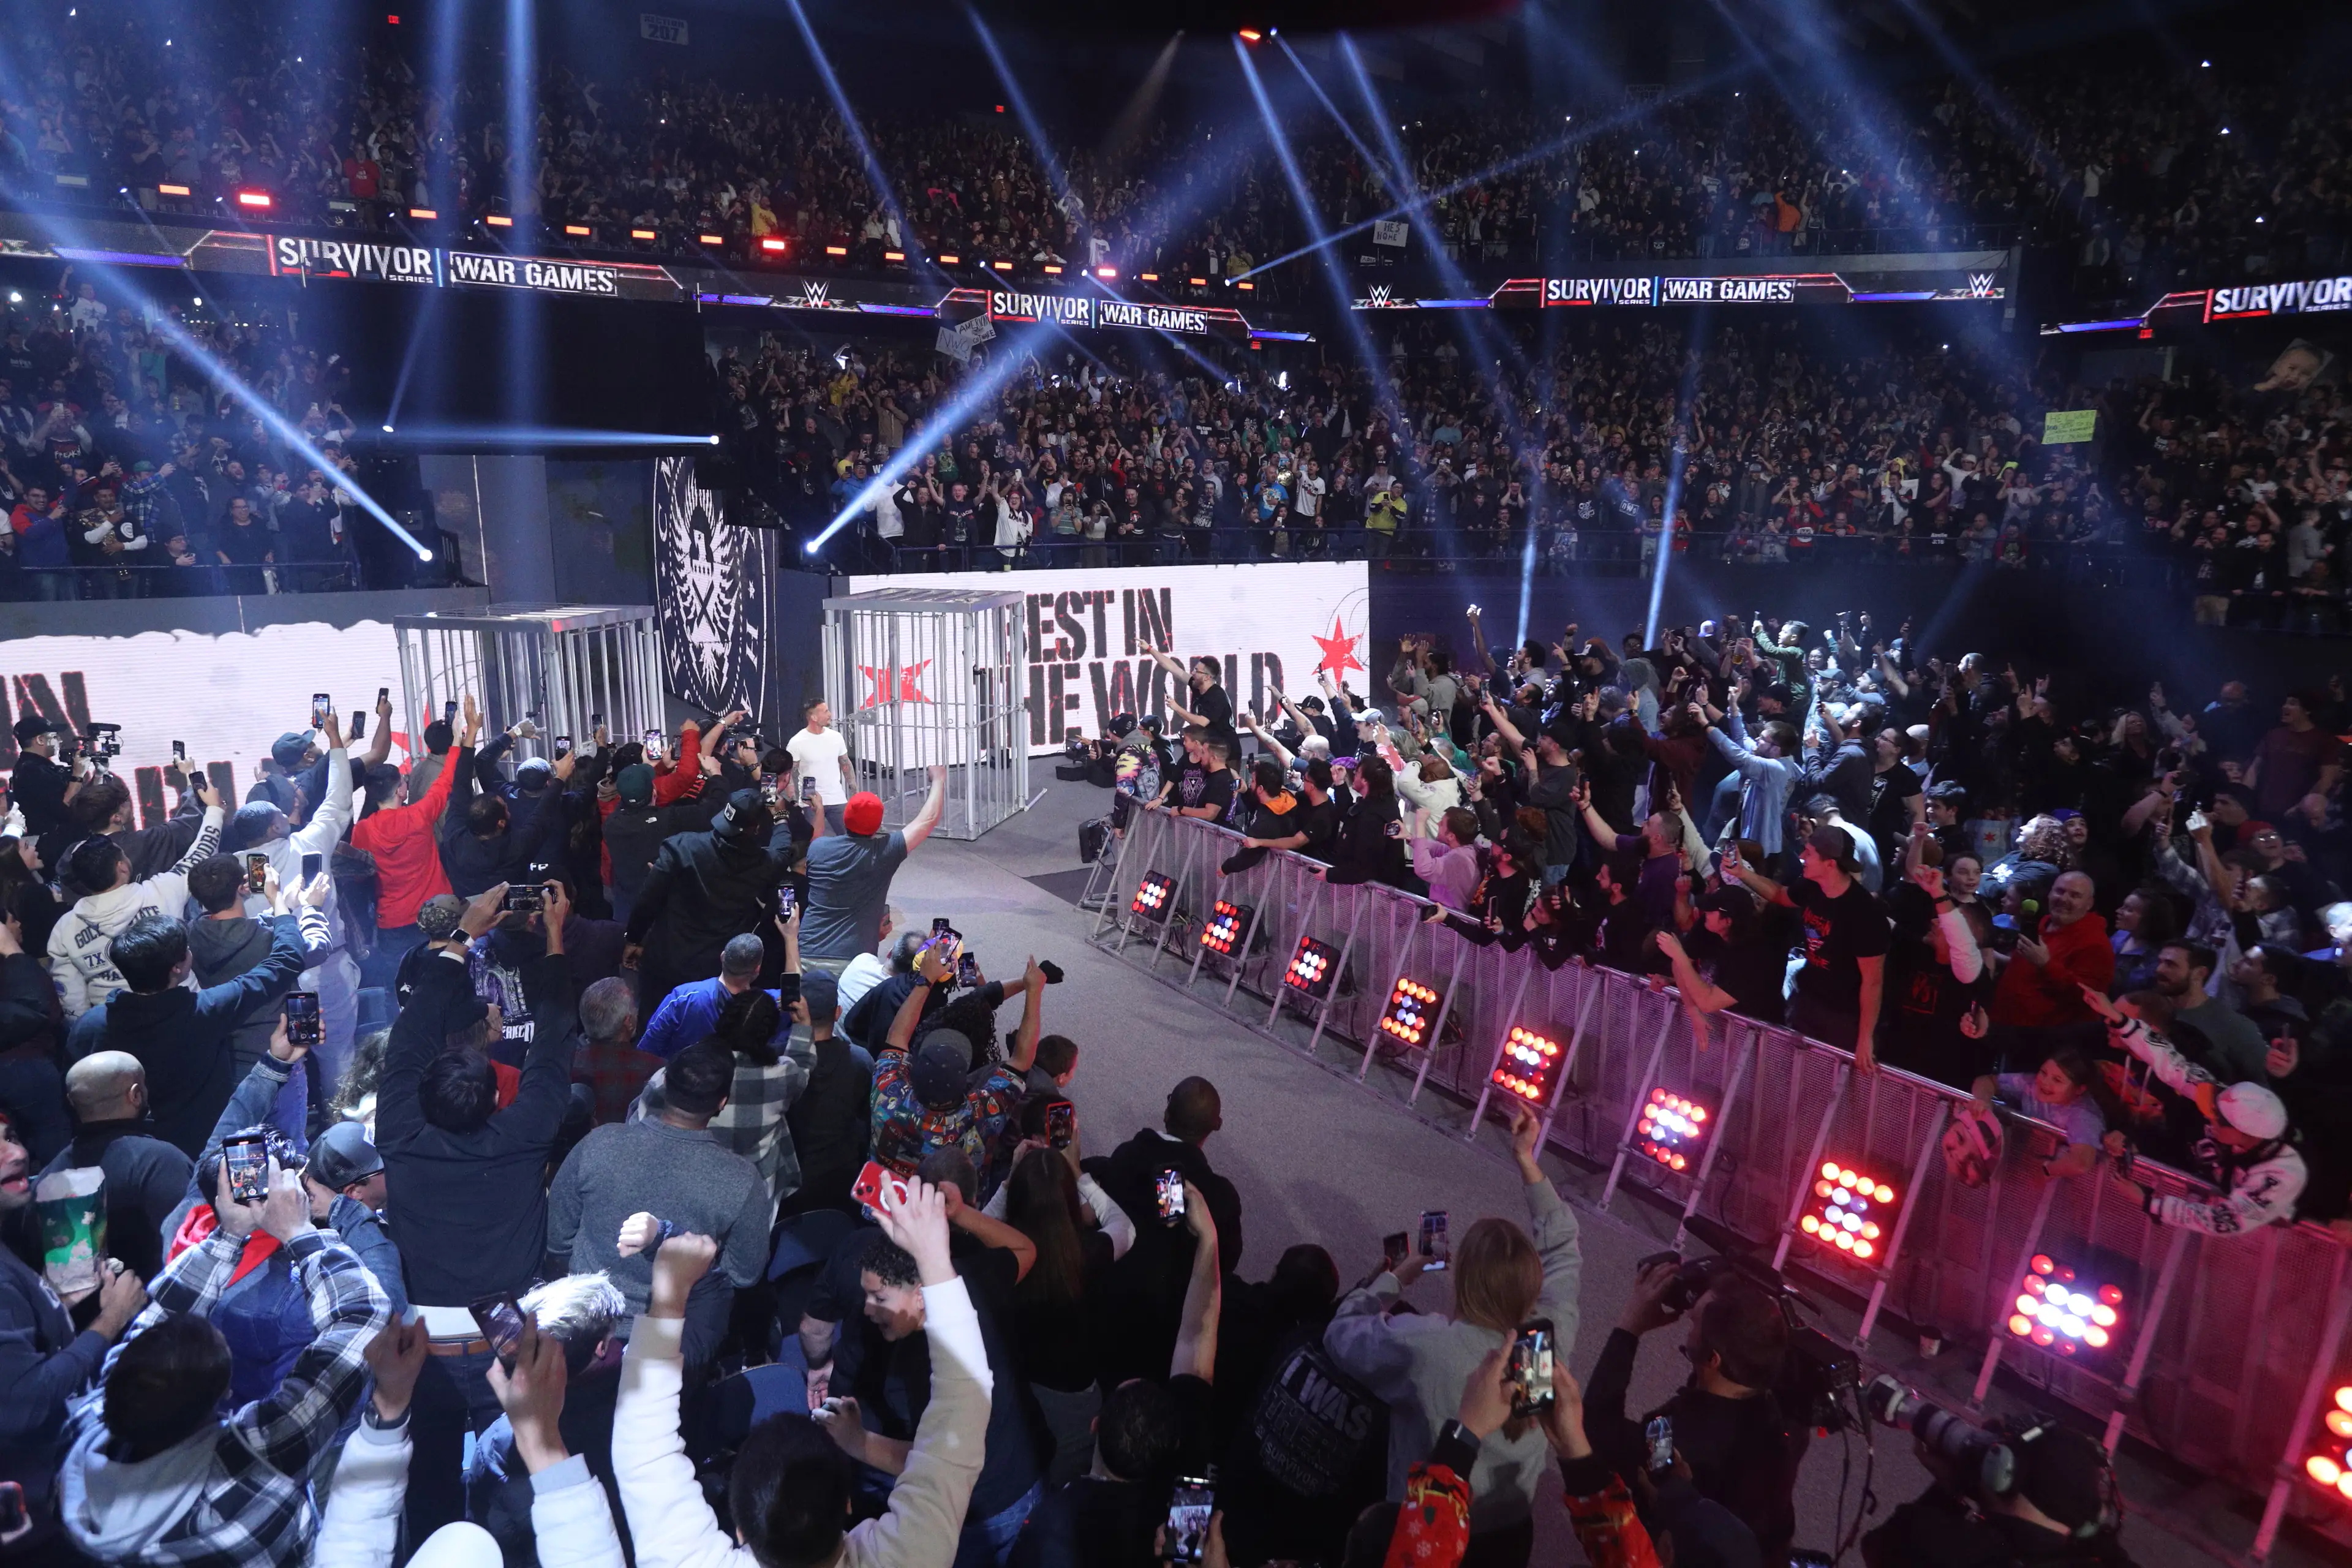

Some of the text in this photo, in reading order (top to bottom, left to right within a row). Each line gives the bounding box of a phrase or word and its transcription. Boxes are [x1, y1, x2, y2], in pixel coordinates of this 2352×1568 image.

[1376, 232, 1397, 241] HOME
[388, 274, 434, 284] SERIES
[454, 256, 613, 293] WAR GAMES
[1547, 278, 1651, 305] SURVIVOR
[1668, 281, 1792, 300] WAR GAMES
[2213, 277, 2352, 314] SURVIVOR
[993, 292, 1090, 324] SURVIVOR
[1104, 304, 1206, 331] WAR GAMES
[1123, 587, 1174, 656] IN
[1088, 652, 1284, 739] WOLD
[84, 952, 105, 967] 7X
[1280, 1355, 1373, 1441] I WAS
